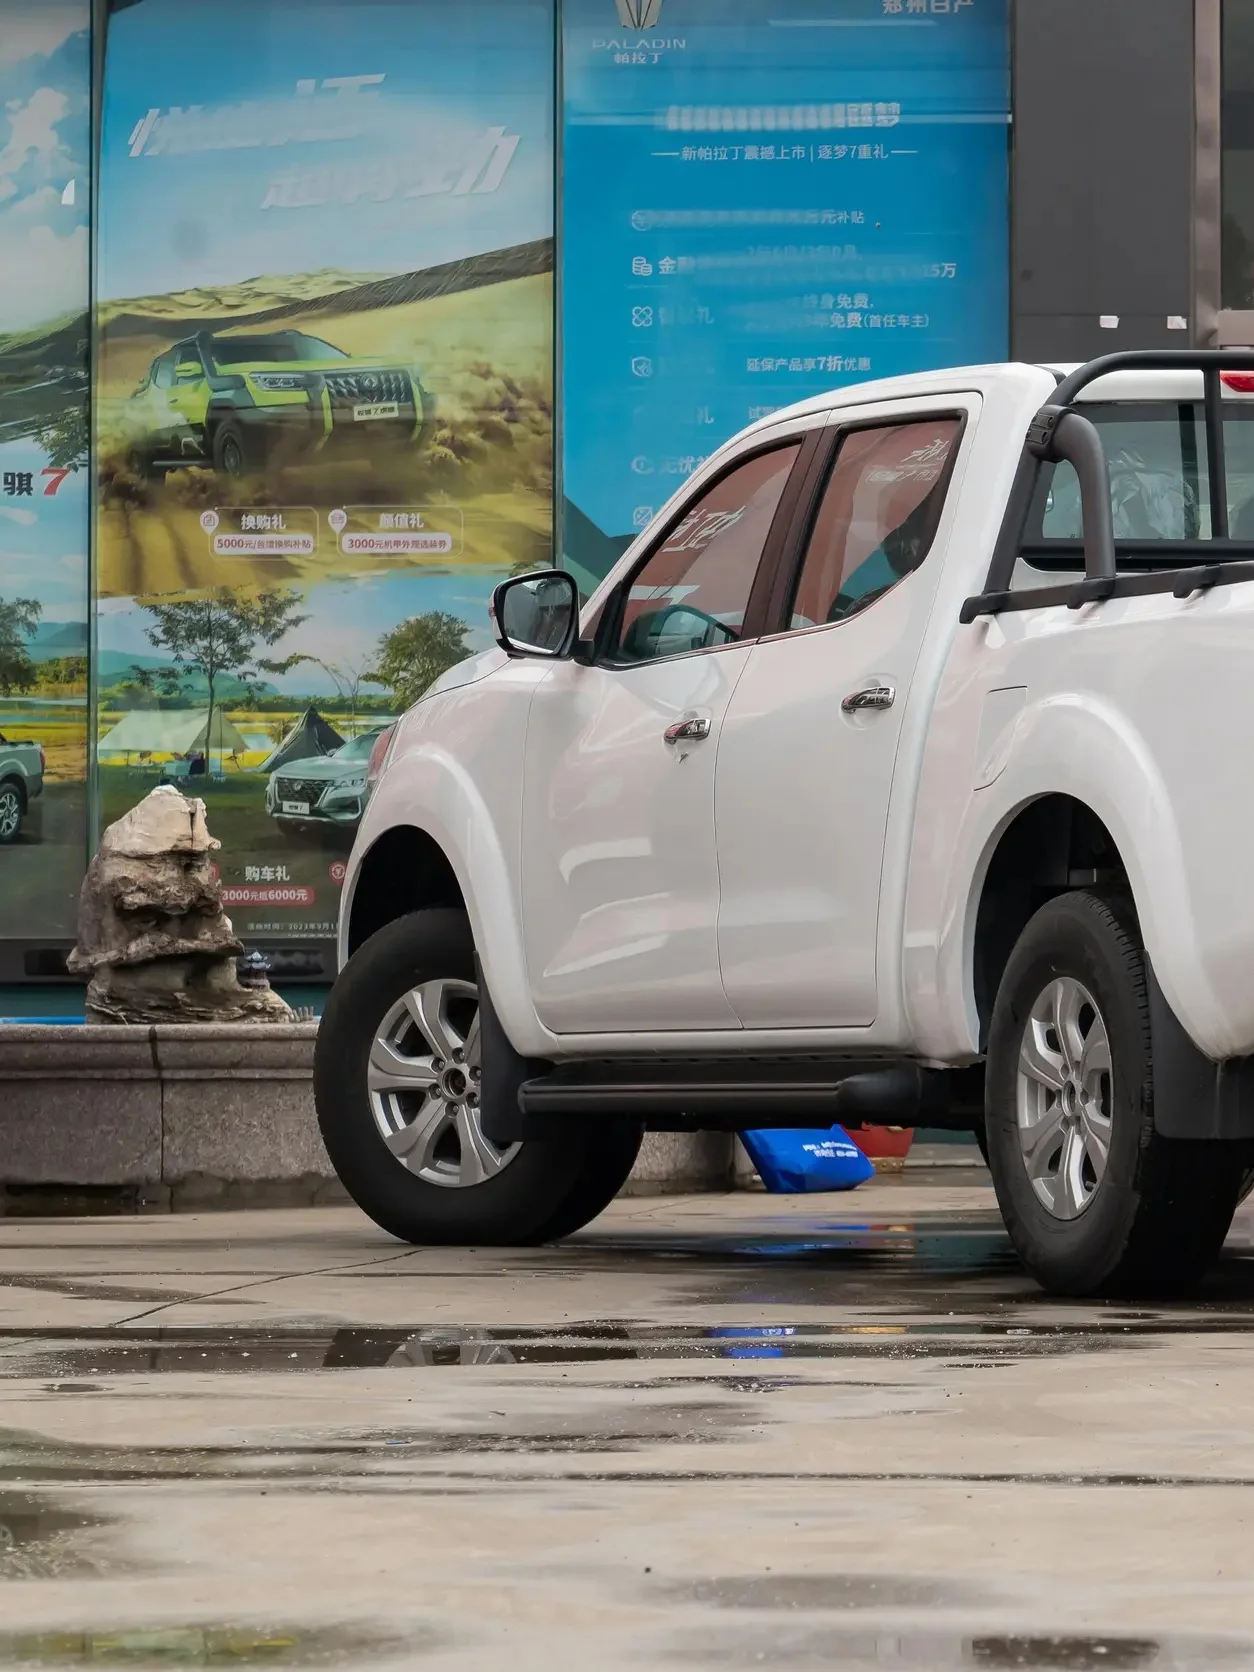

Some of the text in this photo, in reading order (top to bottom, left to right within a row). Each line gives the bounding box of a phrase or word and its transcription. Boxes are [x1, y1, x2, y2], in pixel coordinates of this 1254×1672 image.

[592, 38, 686, 50] PALADIN
[614, 52, 664, 65] 帕拉丁
[747, 355, 871, 372] 延保产品享7折优惠
[240, 514, 287, 530] 换购礼
[245, 865, 291, 882] 购车礼
